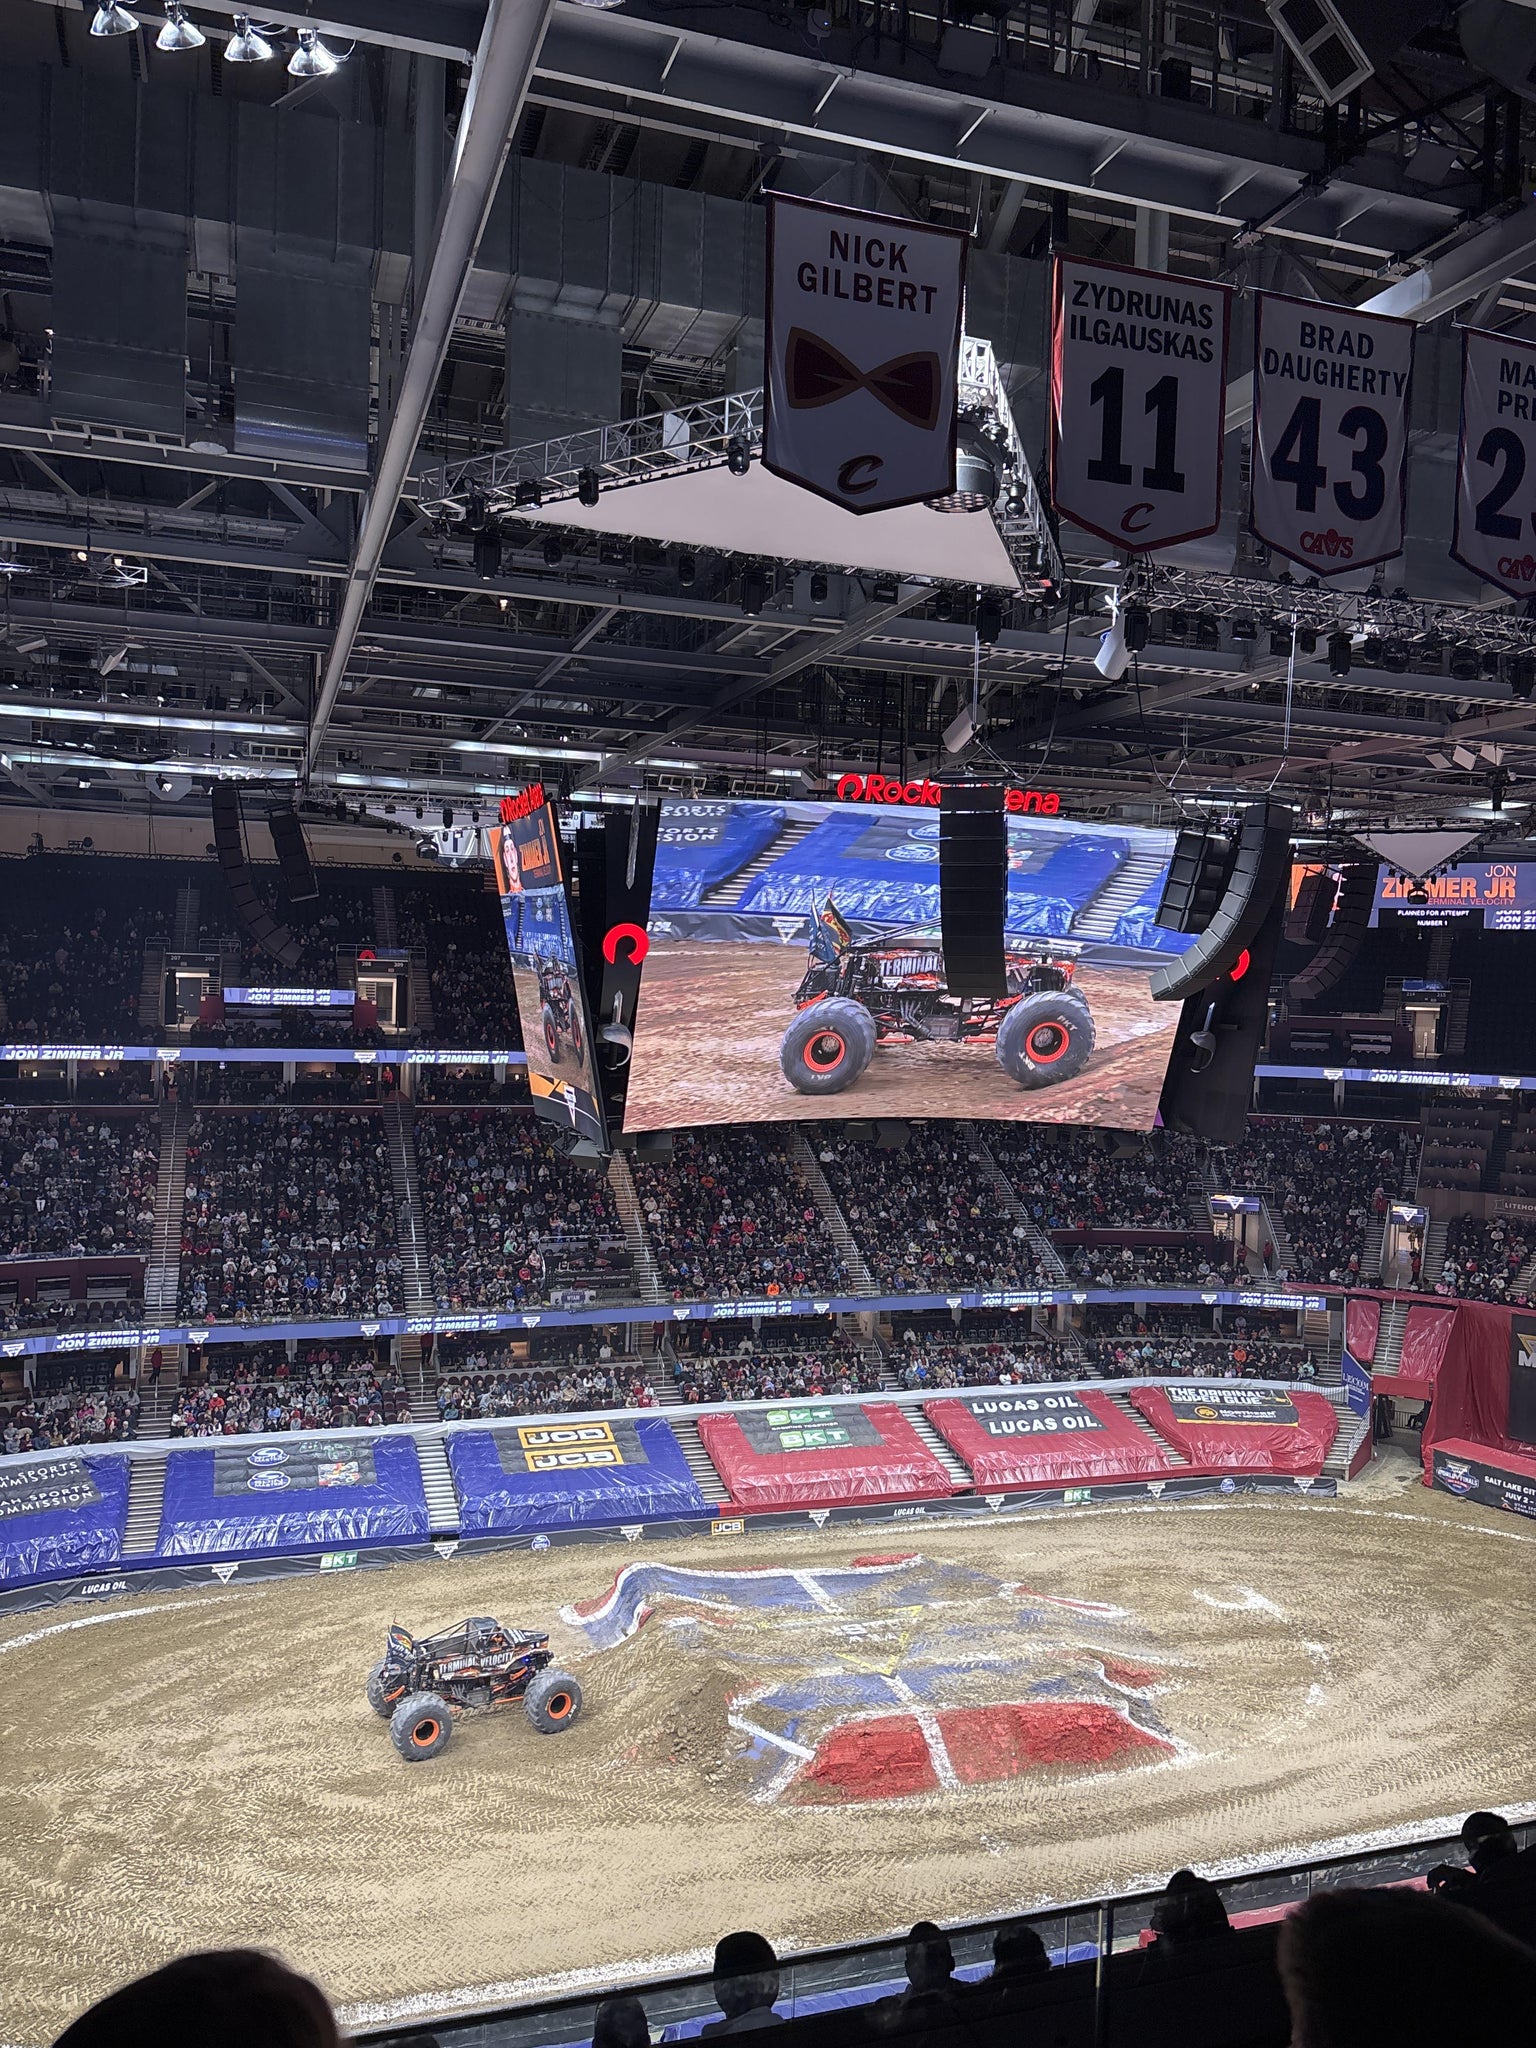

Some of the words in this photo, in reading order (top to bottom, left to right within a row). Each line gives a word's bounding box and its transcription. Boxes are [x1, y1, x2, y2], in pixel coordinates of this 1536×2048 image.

[829, 230, 908, 274] NICK
[797, 261, 938, 315] GILBERT
[1071, 279, 1213, 330] ZYDRUNAS
[1070, 314, 1214, 363] ILGAUSKAS
[1300, 321, 1374, 360] BRAD
[1263, 347, 1407, 398] DAUGHERTY
[1086, 367, 1186, 494] 11
[1270, 395, 1388, 522] 43
[1475, 427, 1536, 541] 2
[1300, 528, 1354, 559] CAVS
[865, 774, 941, 805] Rock
[1005, 787, 1060, 815] ena
[1484, 864, 1517, 877] JON
[1484, 877, 1516, 898] JR
[880, 955, 941, 977] TERMINAL
[5, 1050, 38, 1060] JON
[41, 1049, 102, 1060] ZIMMER
[104, 1050, 124, 1060] JR
[407, 1054, 435, 1063] JON
[438, 1054, 489, 1064] ZIMMER
[491, 1055, 509, 1064] JR
[1371, 1074, 1398, 1082] JON
[1399, 1075, 1450, 1085] ZIMMER
[1452, 1077, 1470, 1086] JR
[713, 1308, 735, 1316] JON
[737, 1306, 777, 1315] ZIMMER
[1263, 1298, 1304, 1307] ZIMMER
[1305, 1300, 1320, 1308] JR
[407, 1323, 432, 1332] JON
[434, 1321, 479, 1330] ZIMMER
[481, 1320, 498, 1328] JR
[56, 1339, 85, 1349] JON
[87, 1337, 140, 1347] ZIMMER
[142, 1335, 160, 1344] JR
[1167, 1387, 1197, 1396] THE
[972, 1399, 1039, 1414] LUCAS
[1224, 1396, 1262, 1405] GLUE
[989, 1417, 1058, 1434] LUCAS
[527, 1427, 606, 1444] JCB
[780, 1430, 846, 1447] BKT
[535, 1451, 615, 1467] JCB
[18, 1461, 78, 1480] SPORTS
[29, 1483, 90, 1501] SPORTS
[1484, 1475, 1502, 1487] SALT
[1502, 1481, 1522, 1492] LAKE
[1064, 1490, 1091, 1502] BKT
[1505, 1491, 1522, 1501] JULY
[1522, 1496, 1529, 1504] 2
[894, 1508, 914, 1516] LUCAS
[715, 1522, 741, 1533] JCB
[321, 1554, 357, 1568] BKT
[81, 1583, 111, 1595] LUCAS
[112, 1581, 127, 1590] OIL
[439, 1656, 478, 1675] TERMINAL
[480, 1651, 514, 1667] VELOCITY
